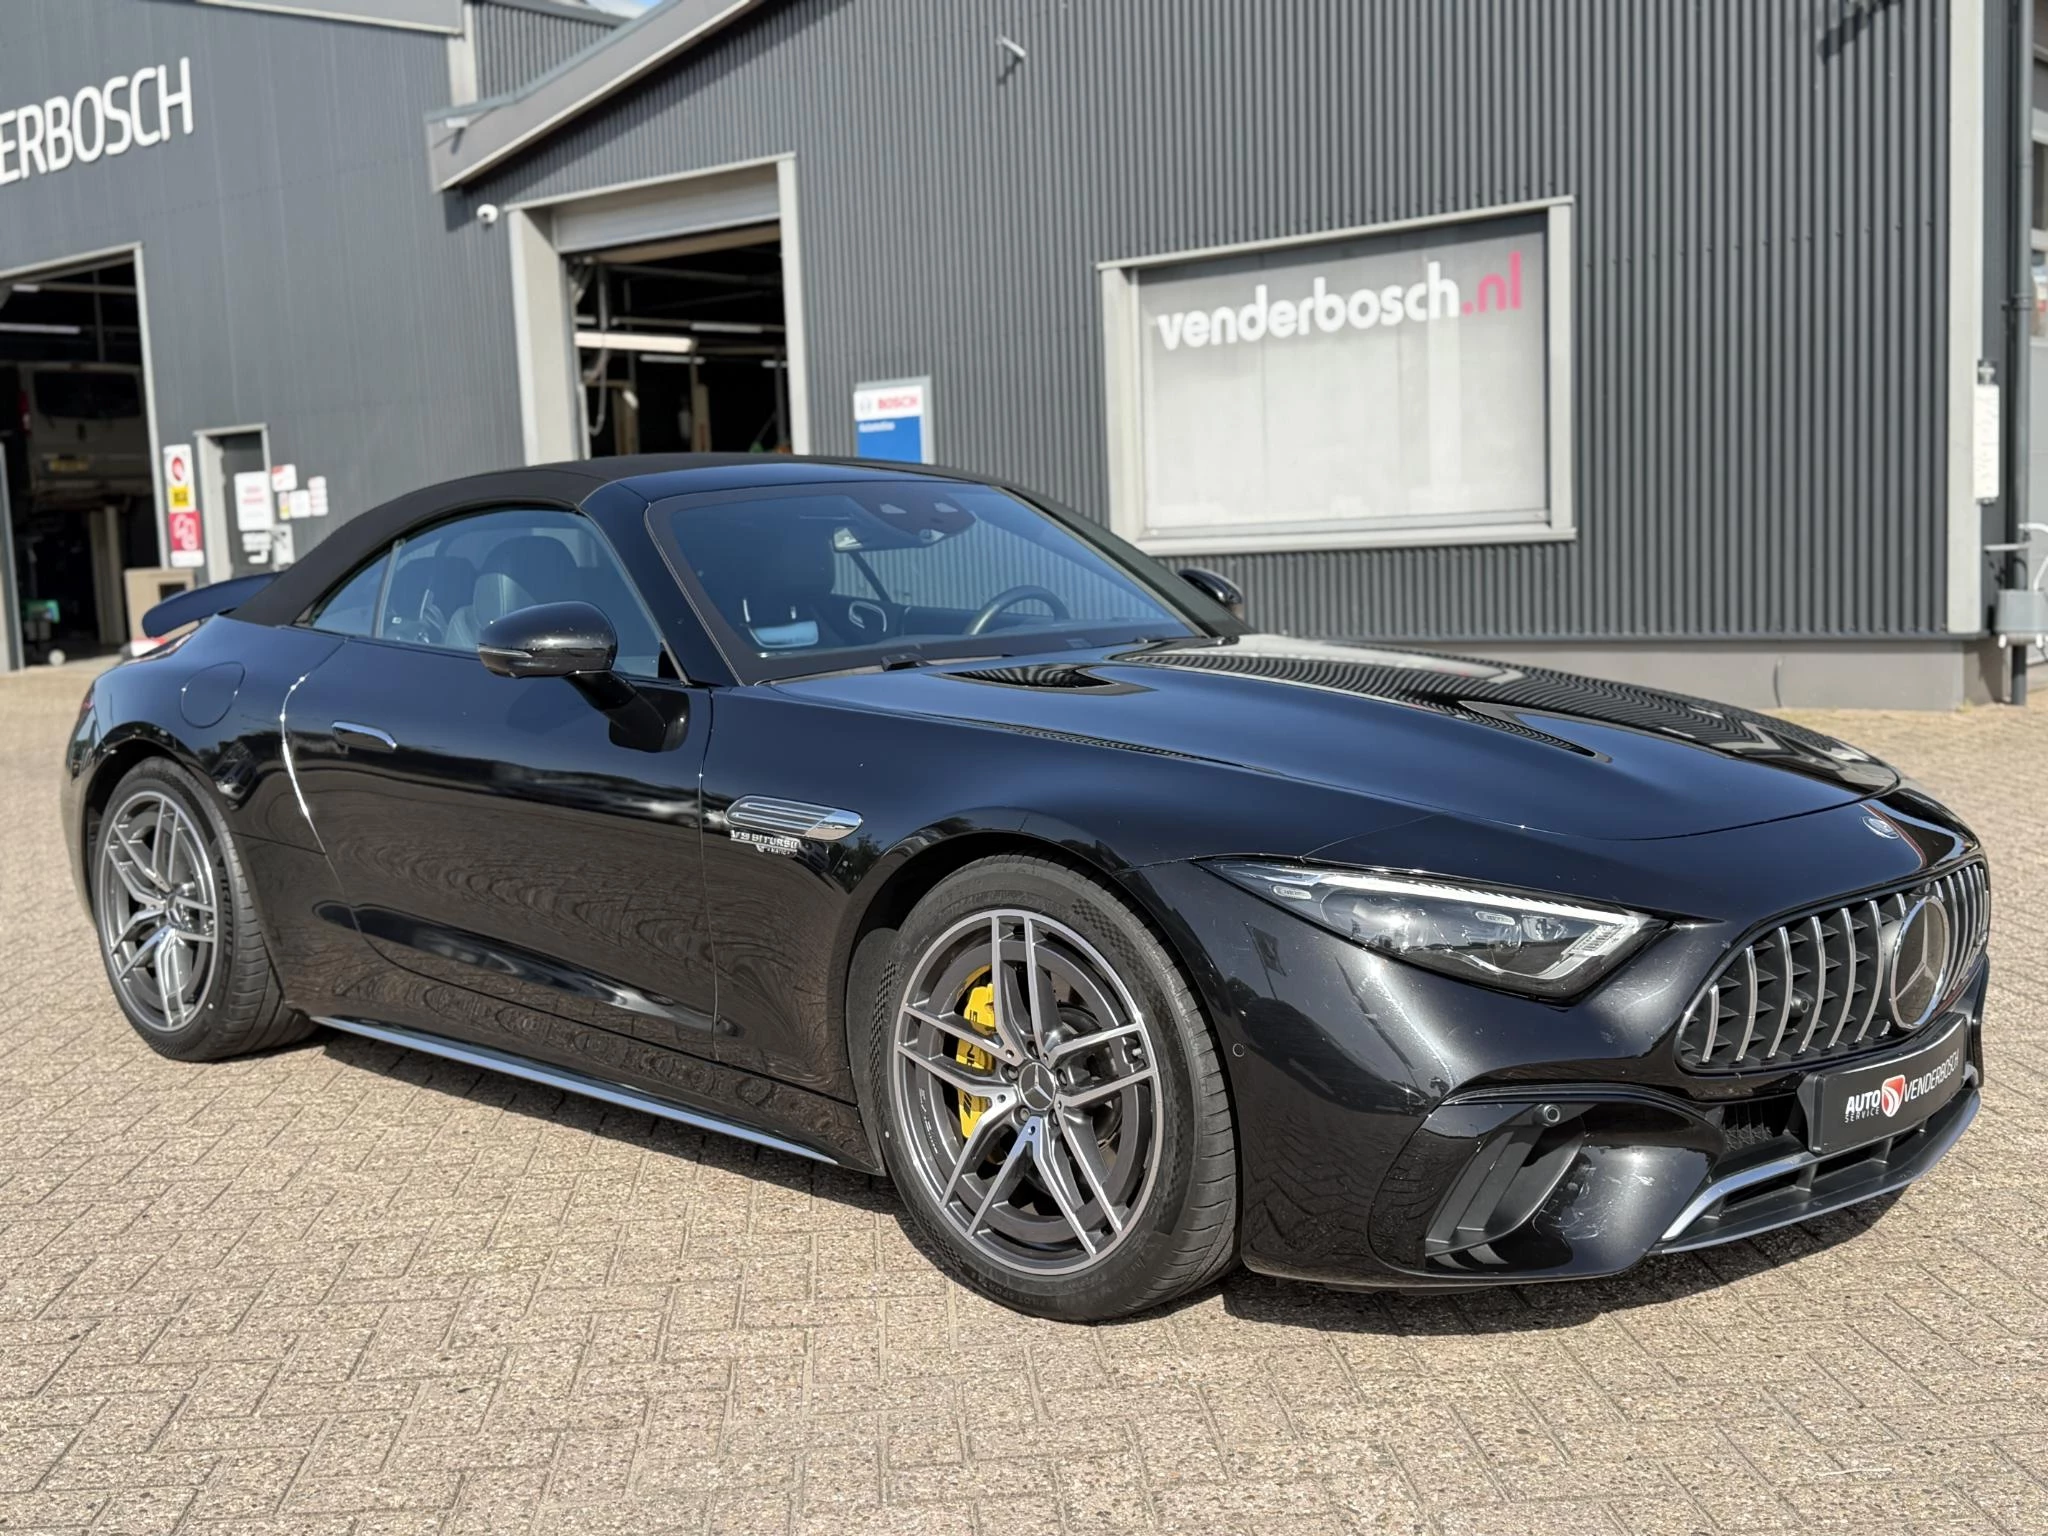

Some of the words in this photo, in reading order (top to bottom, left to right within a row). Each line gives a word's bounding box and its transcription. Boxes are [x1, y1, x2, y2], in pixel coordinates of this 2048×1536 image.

[0, 56, 193, 185] ERBOSCH
[1157, 251, 1522, 350] venderbosch.nl
[1844, 1106, 1880, 1123] SERVICE
[1845, 1089, 1881, 1115] AUTO
[1904, 1048, 1960, 1103] VENDERBOSCH
